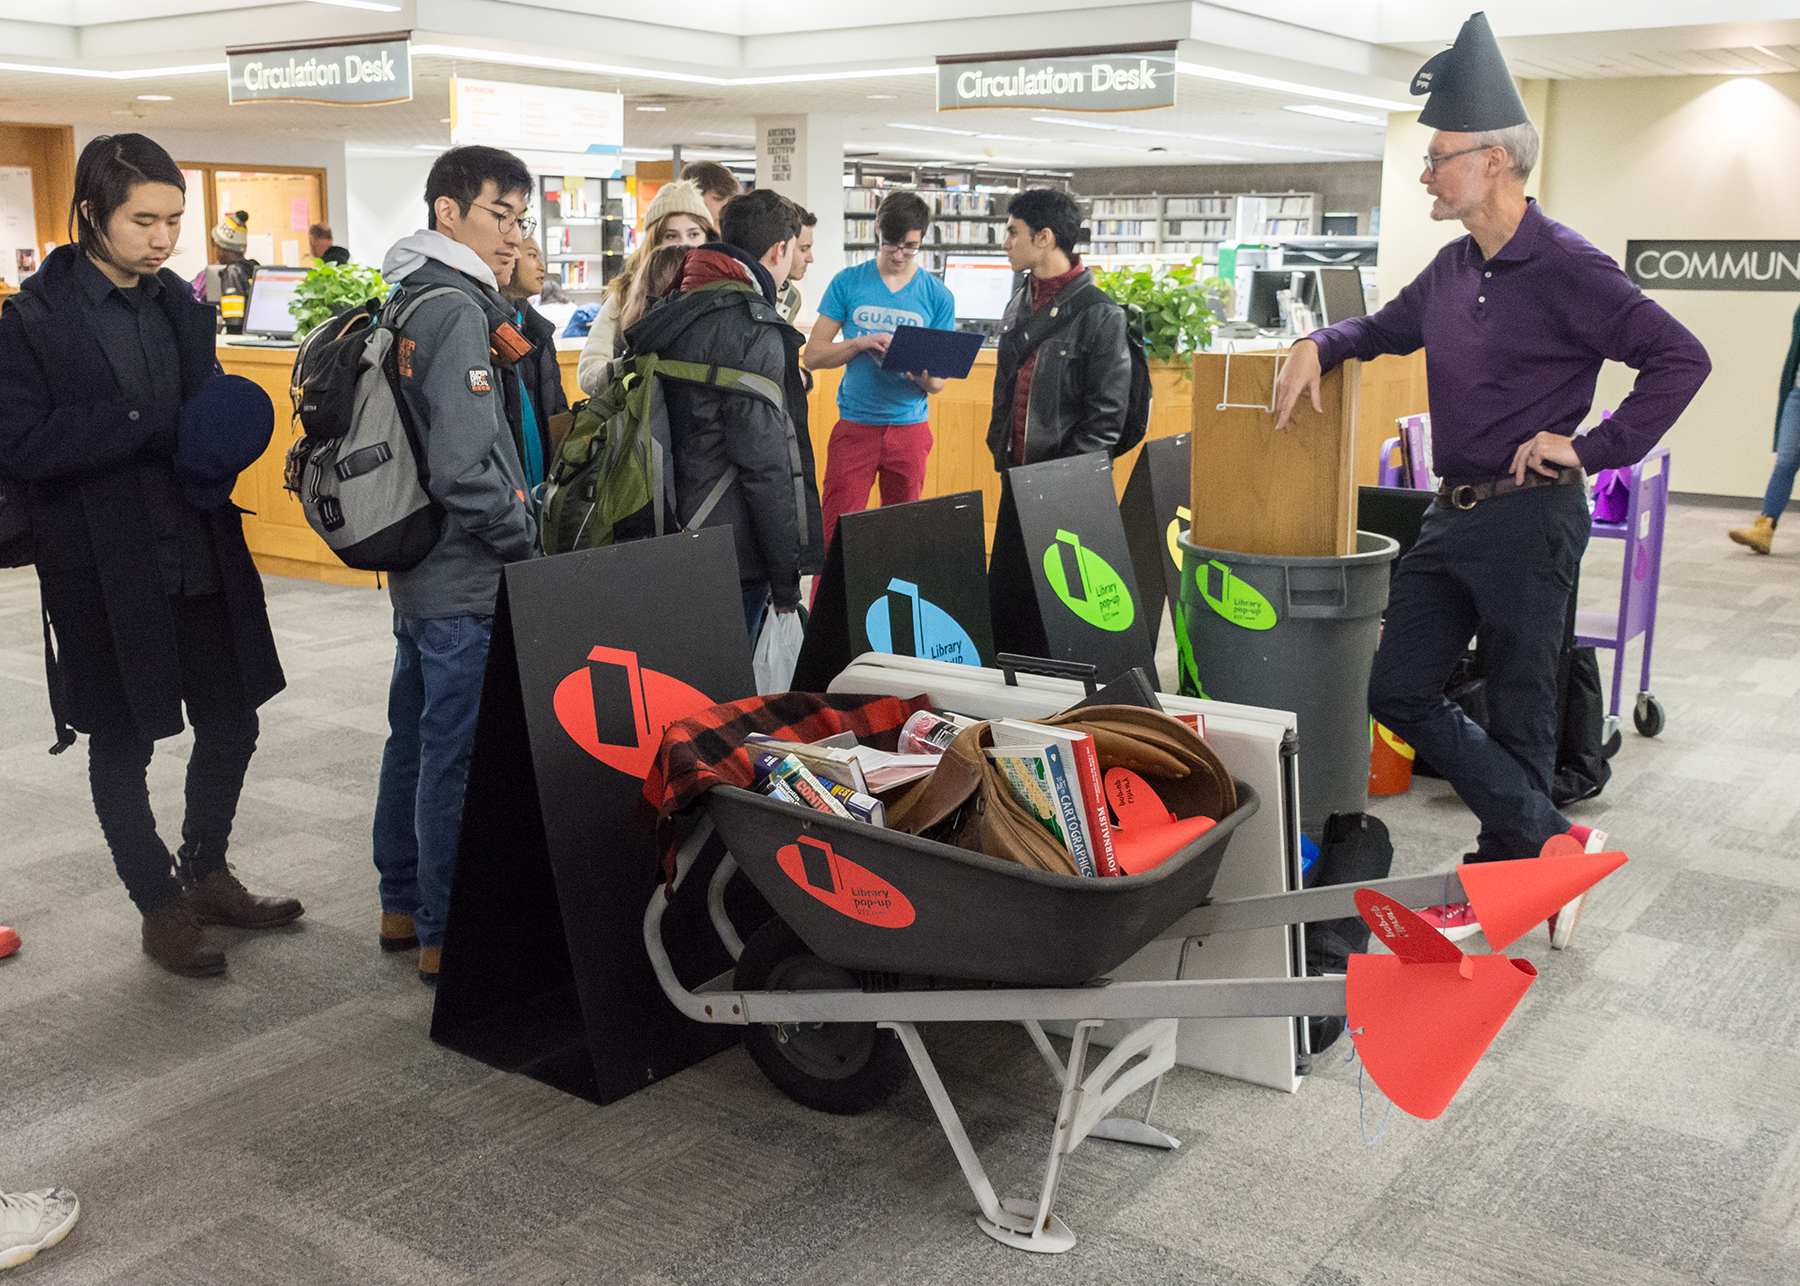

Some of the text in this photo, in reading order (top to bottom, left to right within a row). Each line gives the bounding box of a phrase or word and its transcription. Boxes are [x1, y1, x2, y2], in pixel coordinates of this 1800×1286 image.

[244, 50, 396, 91] Circulation Desk
[957, 60, 1156, 99] Circulation Desk
[1635, 250, 1800, 281] COMMUN
[858, 311, 918, 327] GUARD
[1096, 583, 1118, 597] Library
[1099, 595, 1120, 613] pop-up
[1234, 599, 1262, 608] Library
[1234, 607, 1261, 616] pop-up
[931, 640, 962, 659] Library
[830, 784, 856, 804] WEST
[1060, 794, 1093, 877] CARTOGRAPHICS
[1097, 806, 1117, 872] JOURNALISM
[851, 887, 889, 899] Library
[854, 899, 892, 909] pop-up
